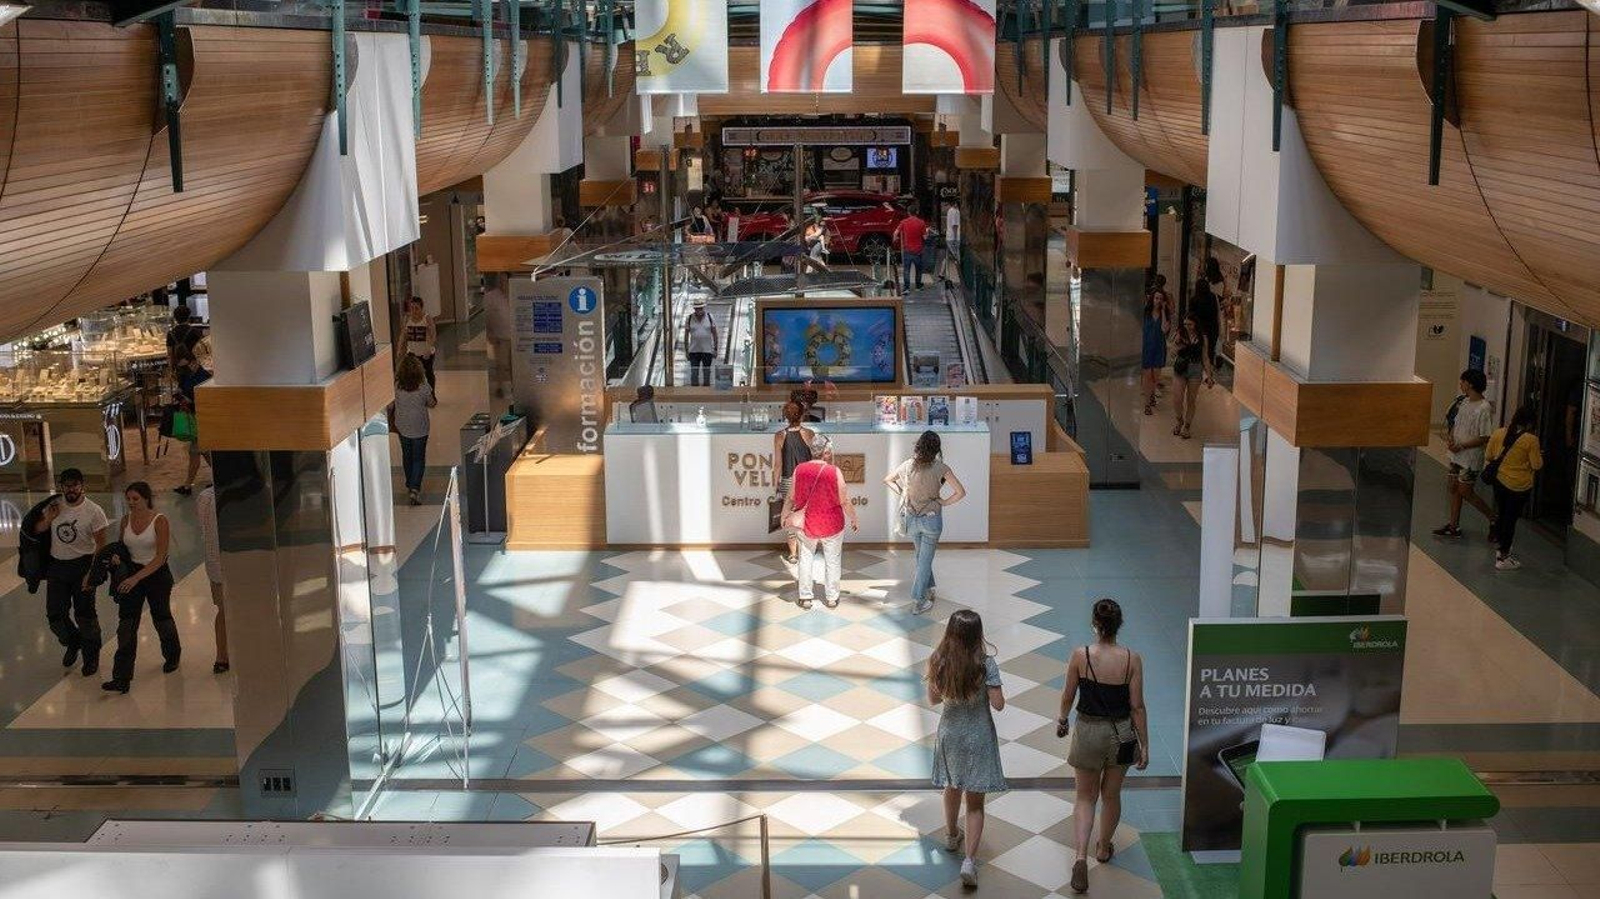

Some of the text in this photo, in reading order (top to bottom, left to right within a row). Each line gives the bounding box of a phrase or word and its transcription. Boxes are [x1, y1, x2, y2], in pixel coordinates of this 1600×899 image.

[727, 452, 773, 470] PON
[721, 495, 762, 506] Centro
[1352, 640, 1399, 650] IBERDROLA
[1200, 667, 1270, 682] PLANES
[1199, 682, 1317, 699] A TU MEDIDA
[1198, 705, 1240, 715] Descubre
[1374, 850, 1465, 865] IBERDROLA
